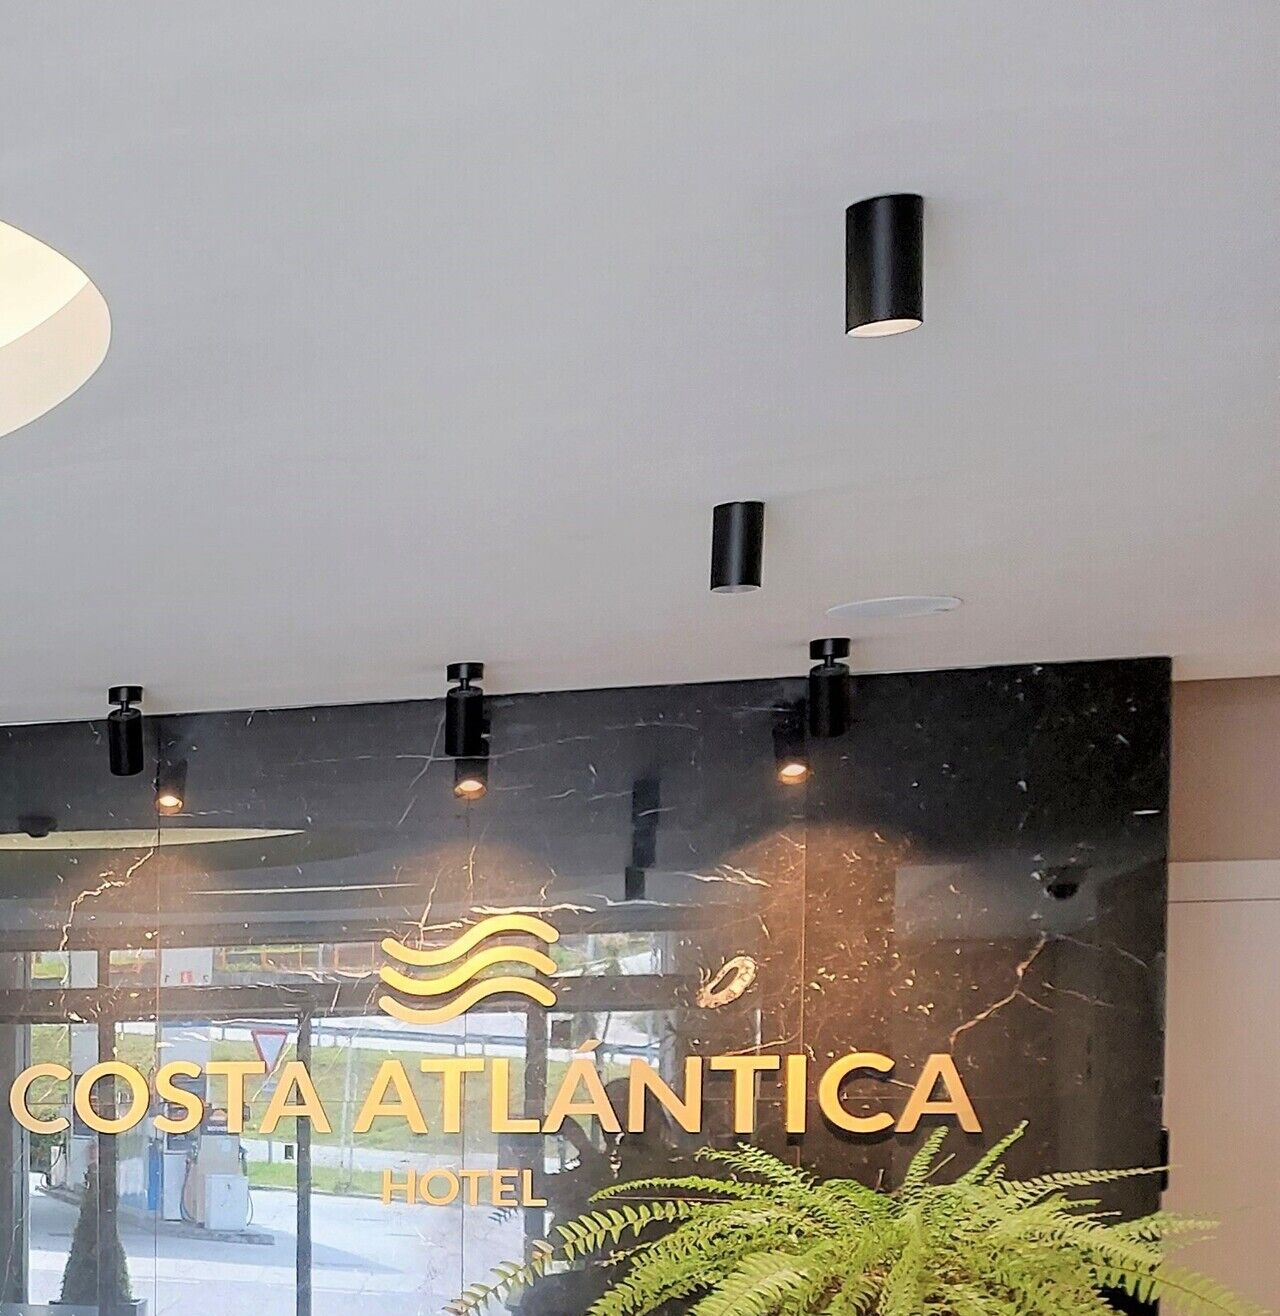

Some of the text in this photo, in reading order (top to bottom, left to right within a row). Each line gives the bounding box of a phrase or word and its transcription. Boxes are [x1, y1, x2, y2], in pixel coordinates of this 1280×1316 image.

[9, 1039, 983, 1134] COSTA ATLÁNTICA
[381, 1168, 547, 1208] HOTEL
